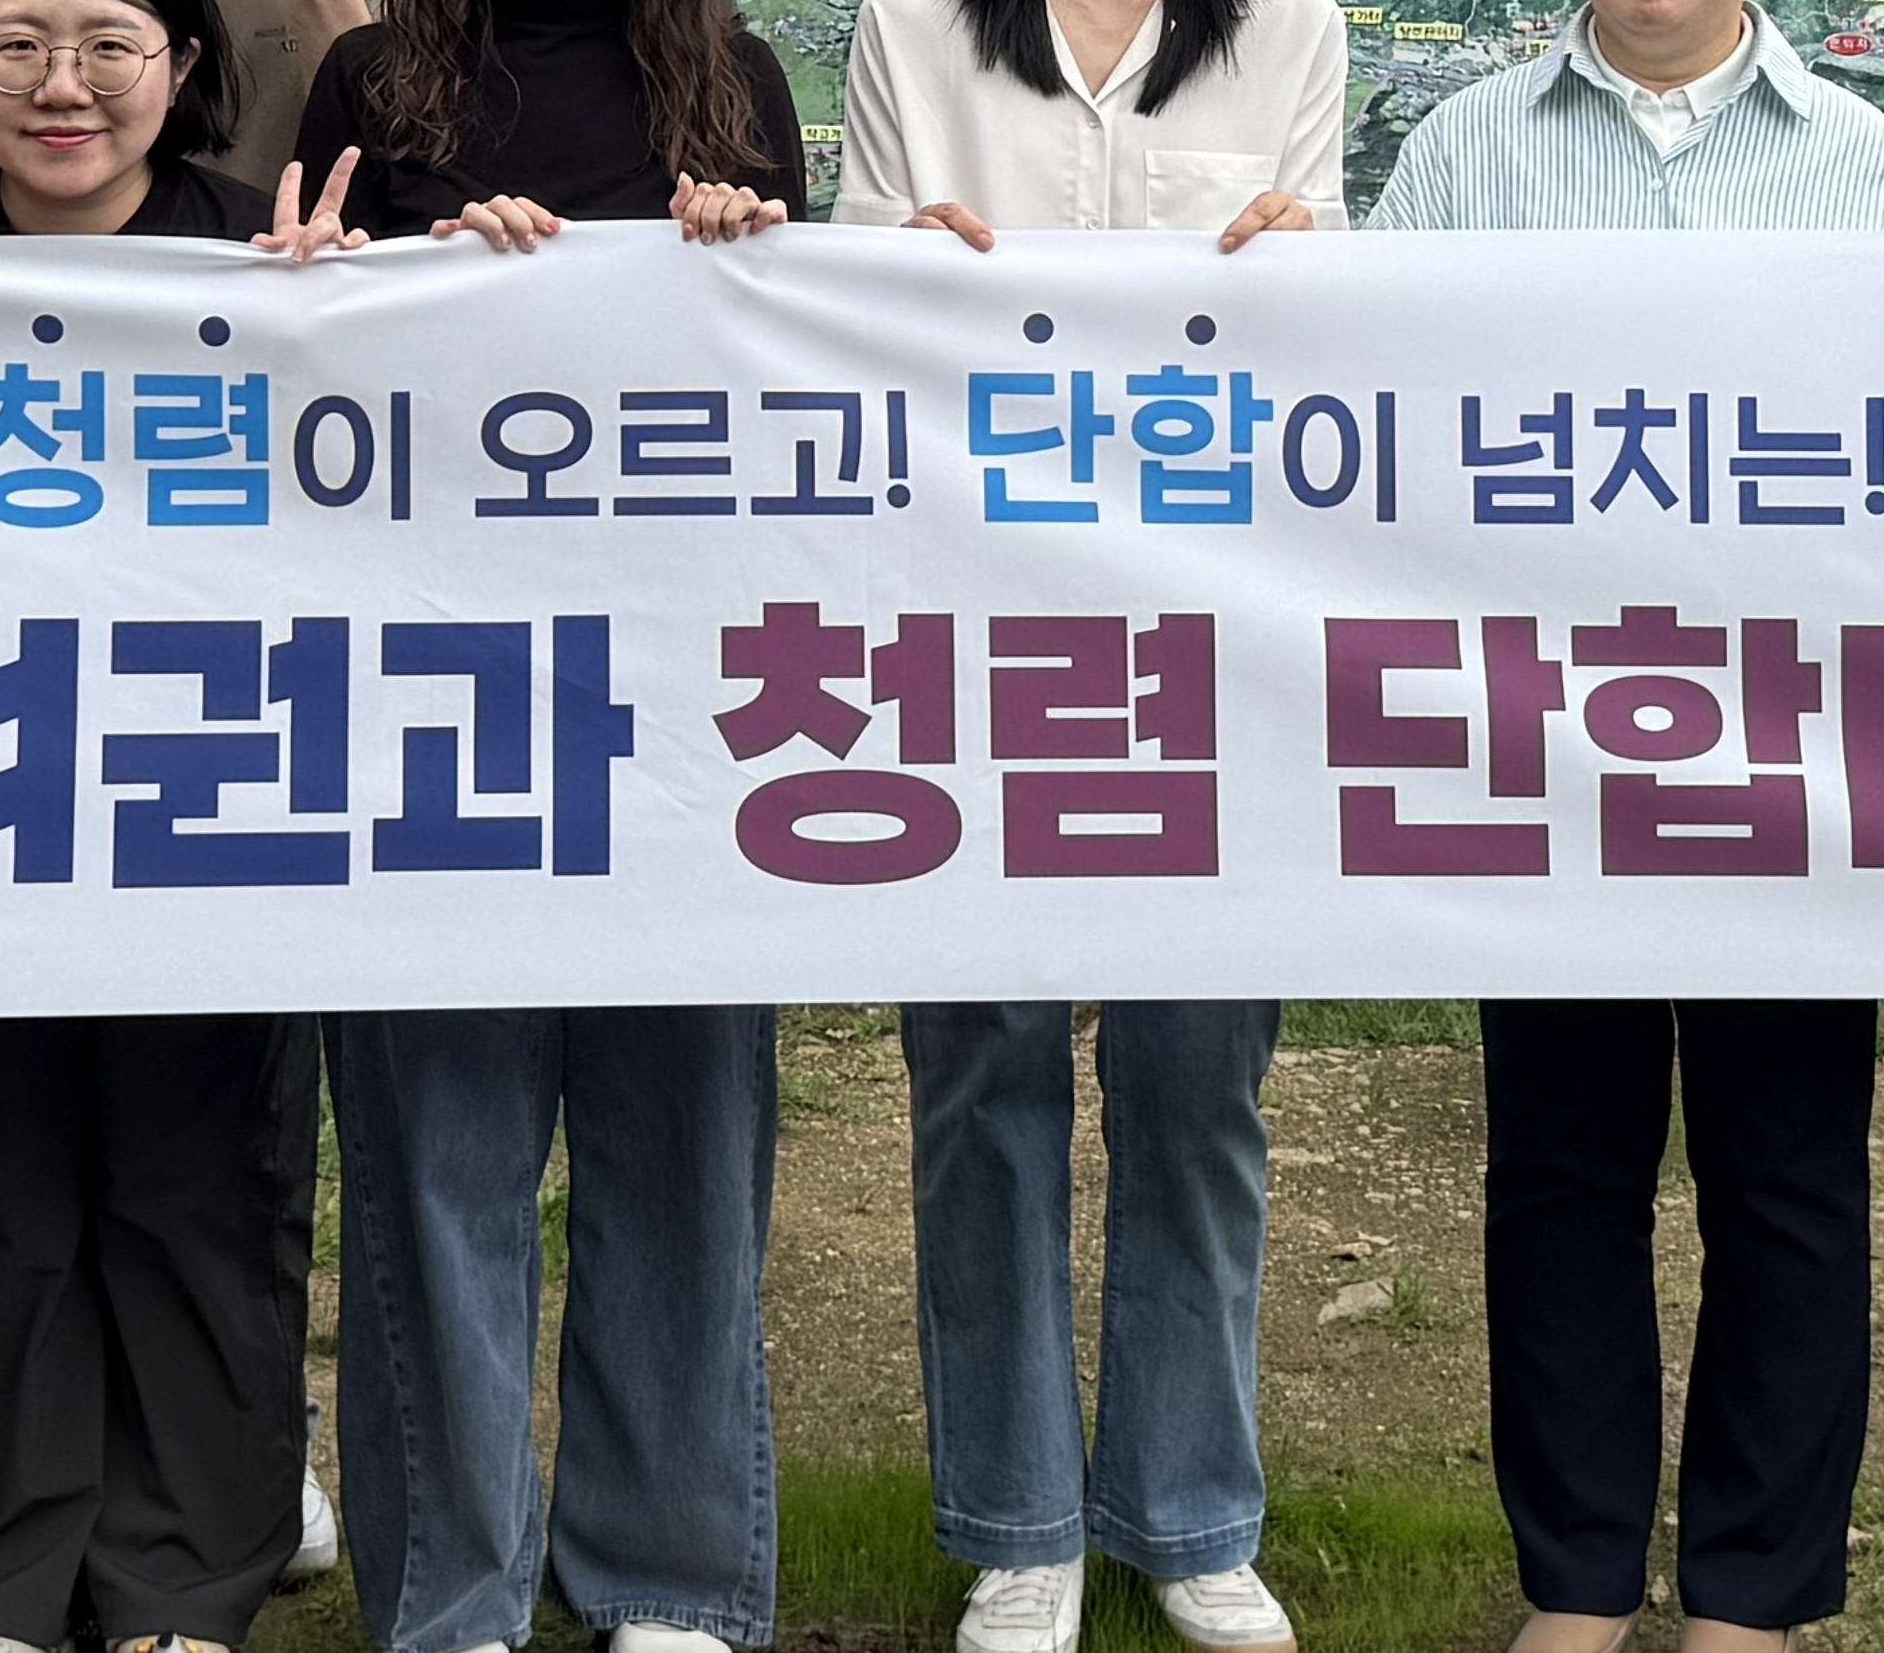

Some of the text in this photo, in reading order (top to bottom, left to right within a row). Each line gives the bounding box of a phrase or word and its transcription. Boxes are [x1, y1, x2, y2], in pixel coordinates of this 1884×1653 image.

[478, 397, 908, 516] 오르고!
[970, 367, 1396, 525] 단합이
[711, 602, 1222, 880] 청렴
